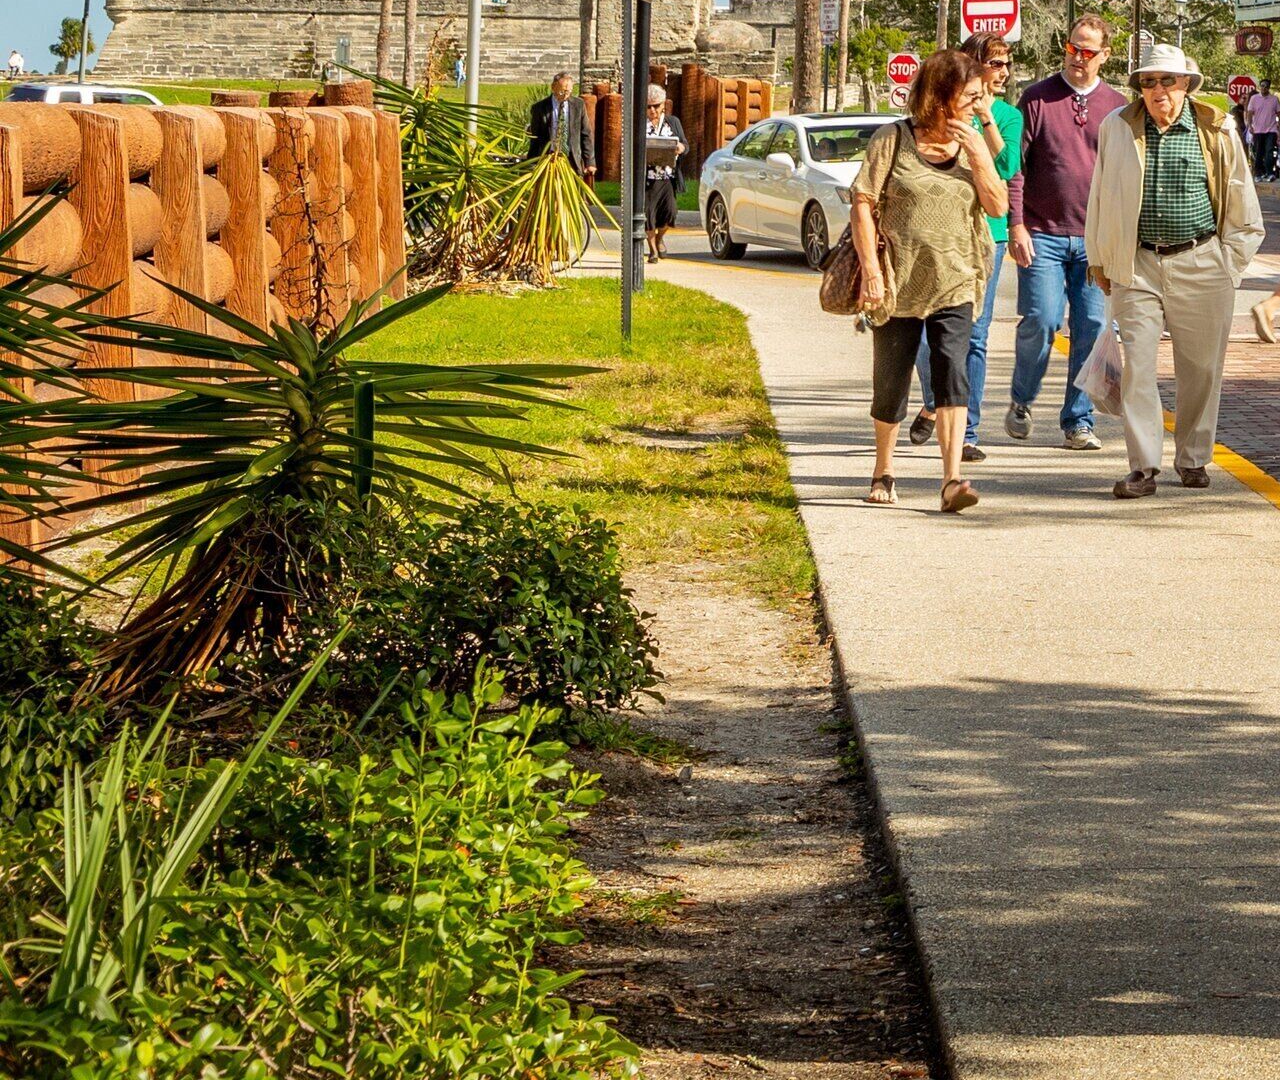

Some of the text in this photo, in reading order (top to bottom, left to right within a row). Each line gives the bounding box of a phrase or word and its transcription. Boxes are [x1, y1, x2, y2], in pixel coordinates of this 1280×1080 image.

[972, 17, 1007, 33] ENTER
[890, 63, 918, 76] STOP
[1229, 83, 1256, 96] STOP
